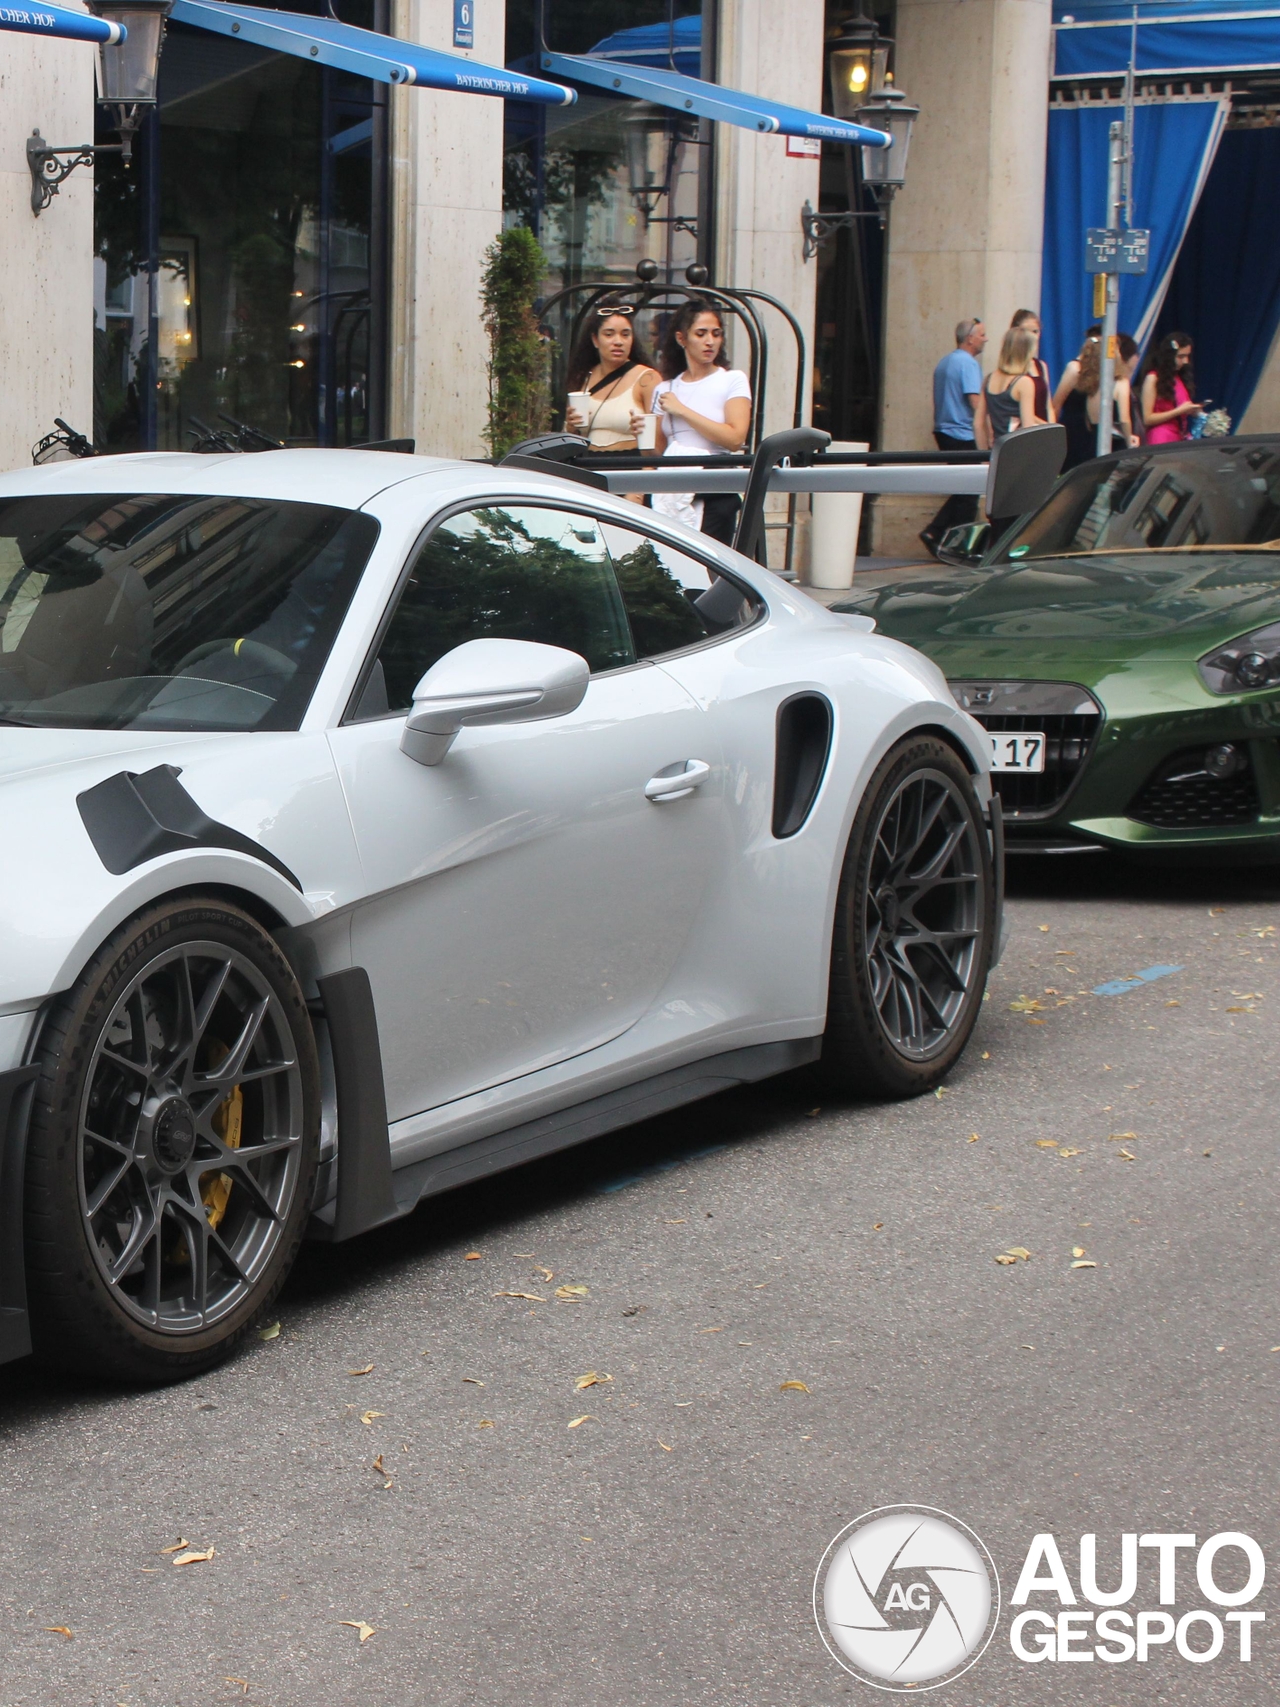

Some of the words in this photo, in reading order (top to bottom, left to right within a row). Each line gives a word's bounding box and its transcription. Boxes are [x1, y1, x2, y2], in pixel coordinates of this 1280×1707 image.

[31, 12, 56, 27] HOF
[461, 4, 470, 25] 6
[455, 74, 511, 92] BAYERISCHER
[511, 82, 529, 95] HOF
[1005, 739, 1041, 767] 17
[102, 920, 171, 995] MICHELIN
[177, 912, 199, 924] PILOT
[201, 912, 227, 922] SPORT
[228, 917, 243, 928] CUP
